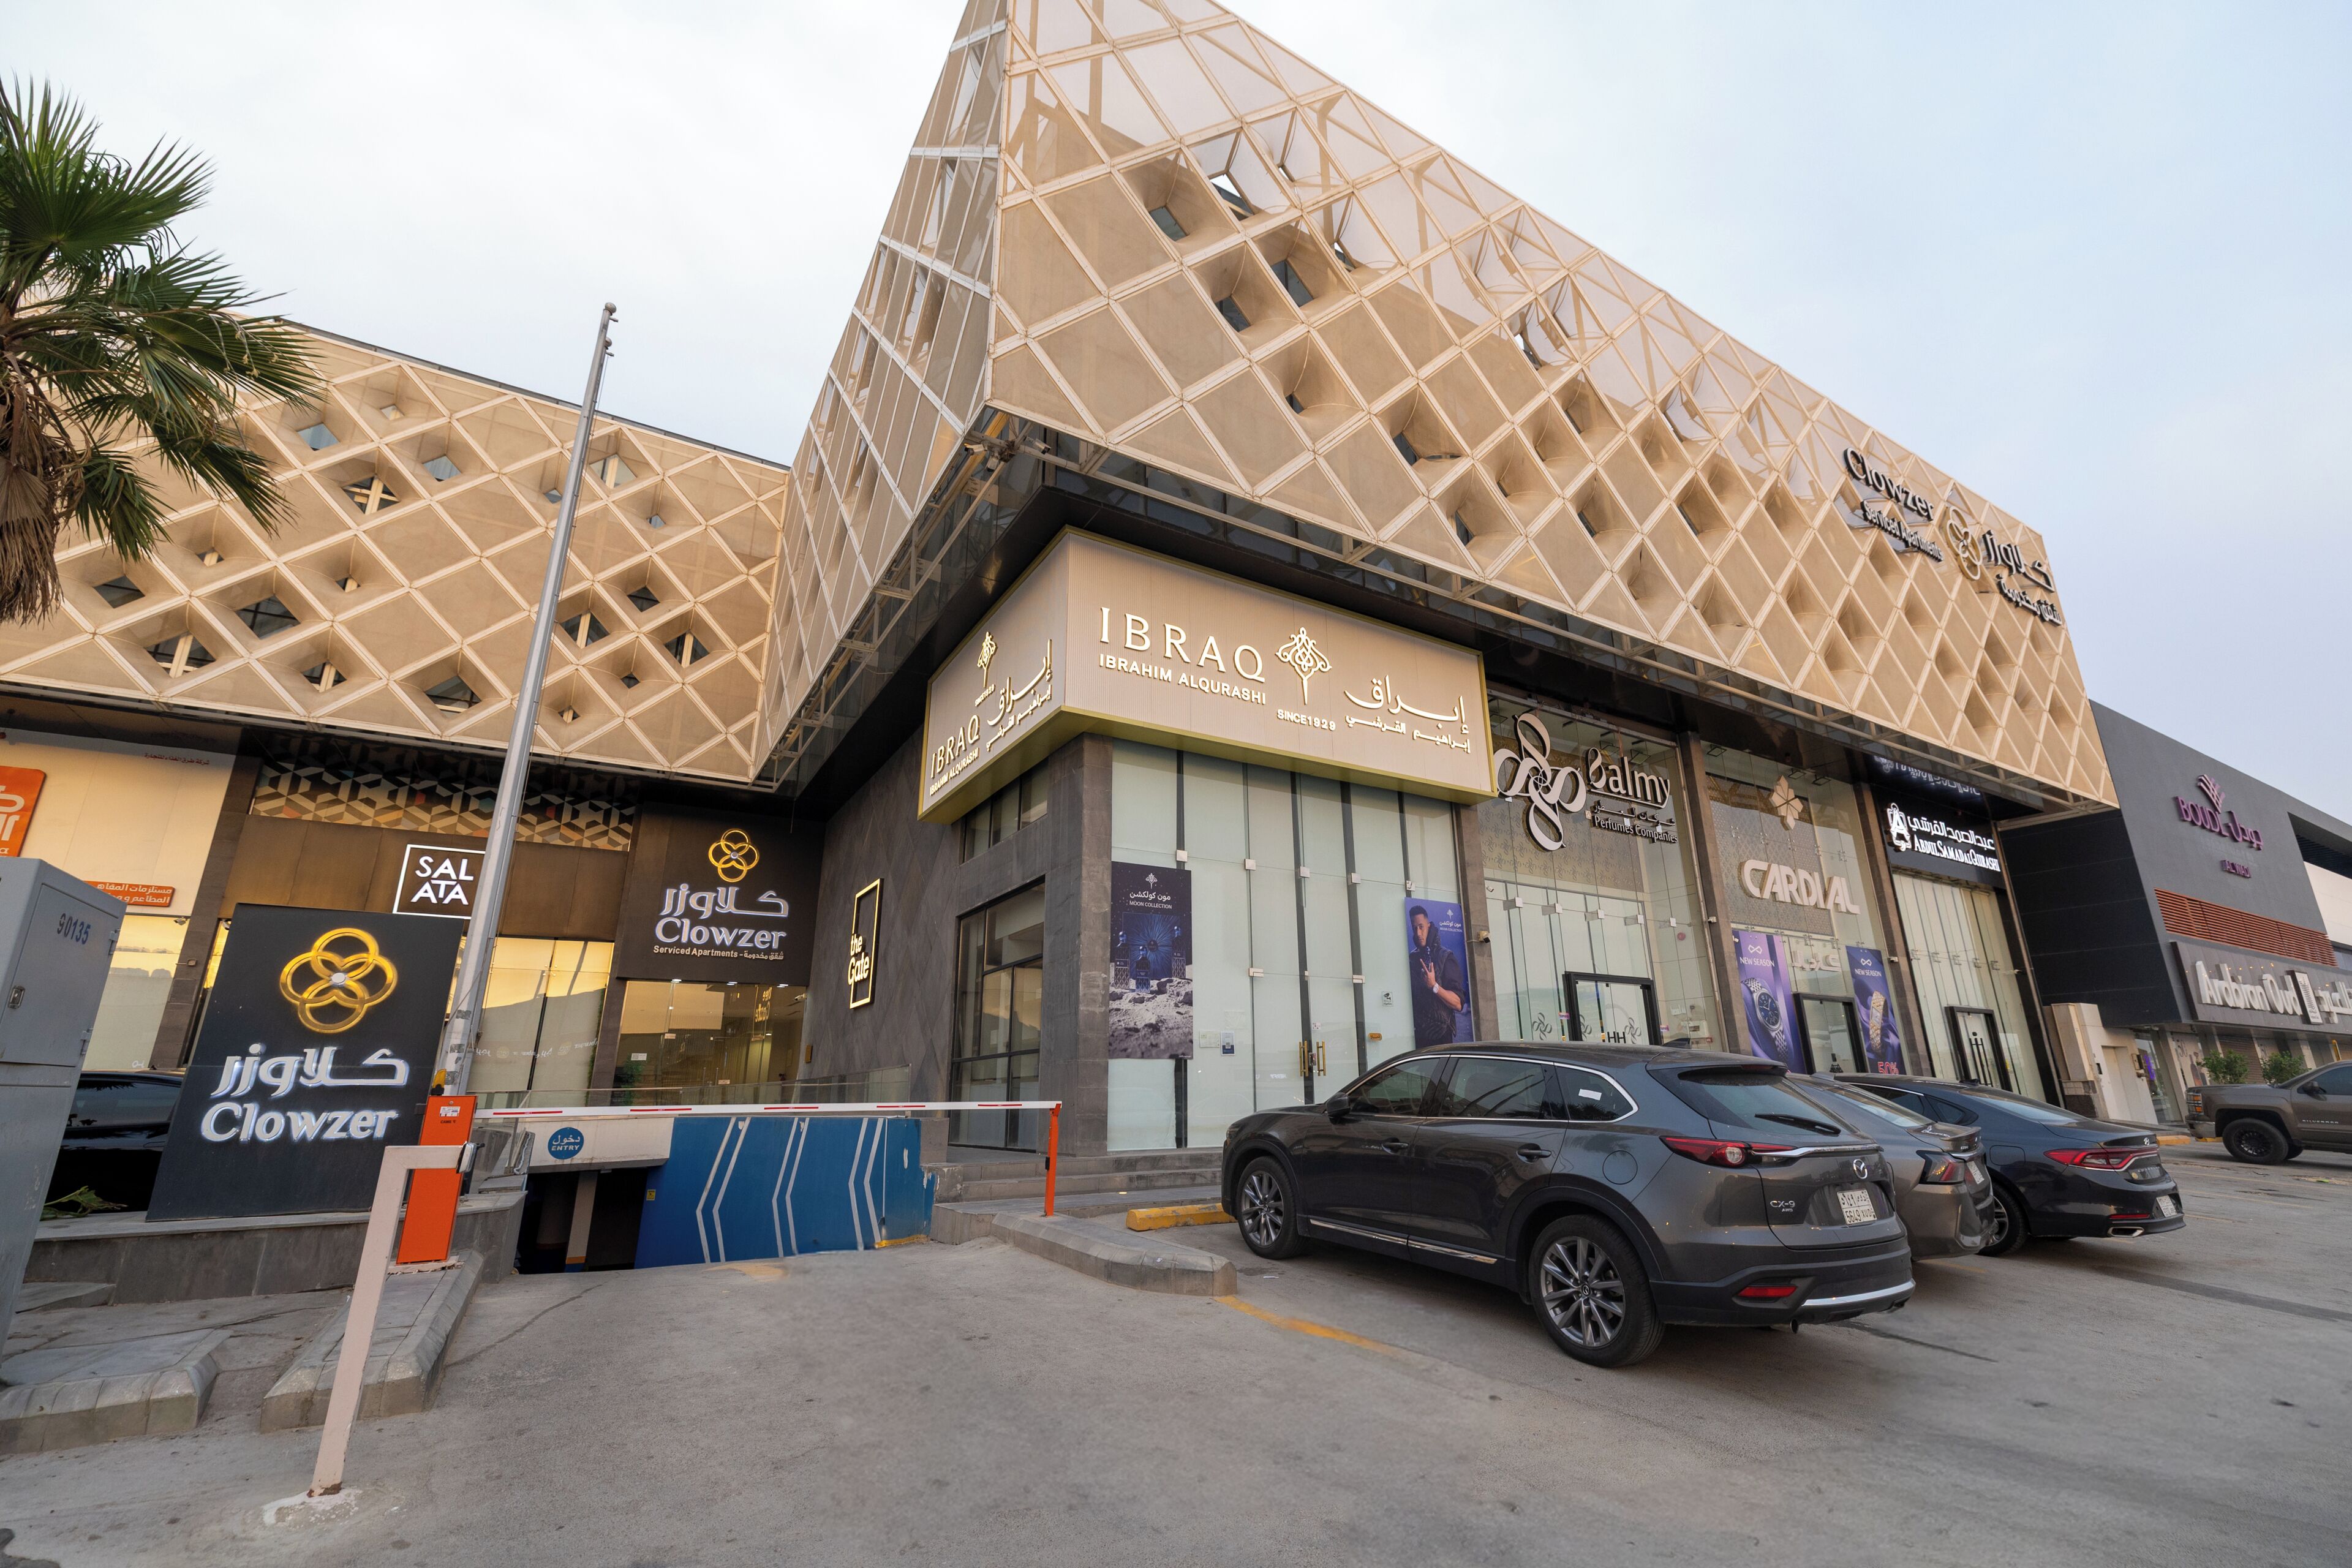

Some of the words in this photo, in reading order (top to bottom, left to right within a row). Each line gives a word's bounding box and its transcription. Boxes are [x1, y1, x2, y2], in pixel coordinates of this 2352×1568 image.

[1844, 447, 1934, 521] Clowzer
[1861, 500, 1901, 539] Serviced
[1899, 521, 1943, 562] Apartments
[1100, 607, 1265, 683] IBRAQ
[987, 639, 1052, 726] إبراق
[1099, 654, 1172, 682] IBRAHIM
[1178, 673, 1267, 705] ALQURASHI
[1344, 674, 1469, 734] إبراق
[986, 715, 1016, 752] القرشي
[1345, 715, 1406, 734] القرشي
[930, 714, 981, 778] IBRAQ
[929, 772, 949, 796] IBRAHIM
[949, 747, 980, 780] ALQURASHI
[1588, 747, 1671, 809] Balmy
[1594, 815, 1634, 834] Perfumes
[1635, 824, 1678, 843] Companies
[2175, 796, 2230, 837] BOUDL
[415, 856, 474, 881] SAL
[97, 883, 129, 891] المقاه
[410, 880, 469, 905] ATA
[659, 883, 790, 919] كلاوزر
[1129, 891, 1156, 900] كولكشن
[1157, 892, 1171, 902] مون
[1740, 859, 1861, 914] CARDIAL
[57, 913, 91, 945] 90135
[655, 916, 788, 949] Clowzer
[850, 933, 863, 956] the
[653, 945, 692, 956] Serviced
[692, 947, 738, 958] Apartments
[744, 950, 768, 960] مخدومة
[768, 951, 784, 960] شقق
[1740, 957, 1753, 965] NEW
[1753, 958, 1775, 967] SEASON
[848, 952, 870, 985] Gate
[2195, 960, 2271, 1011] Arabian
[2261, 973, 2303, 1016] Oud
[210, 1042, 410, 1098] كلاوزر
[200, 1101, 401, 1144] Clowzer
[552, 1135, 581, 1145] دخول
[1845, 1209, 1862, 1223] 5649
